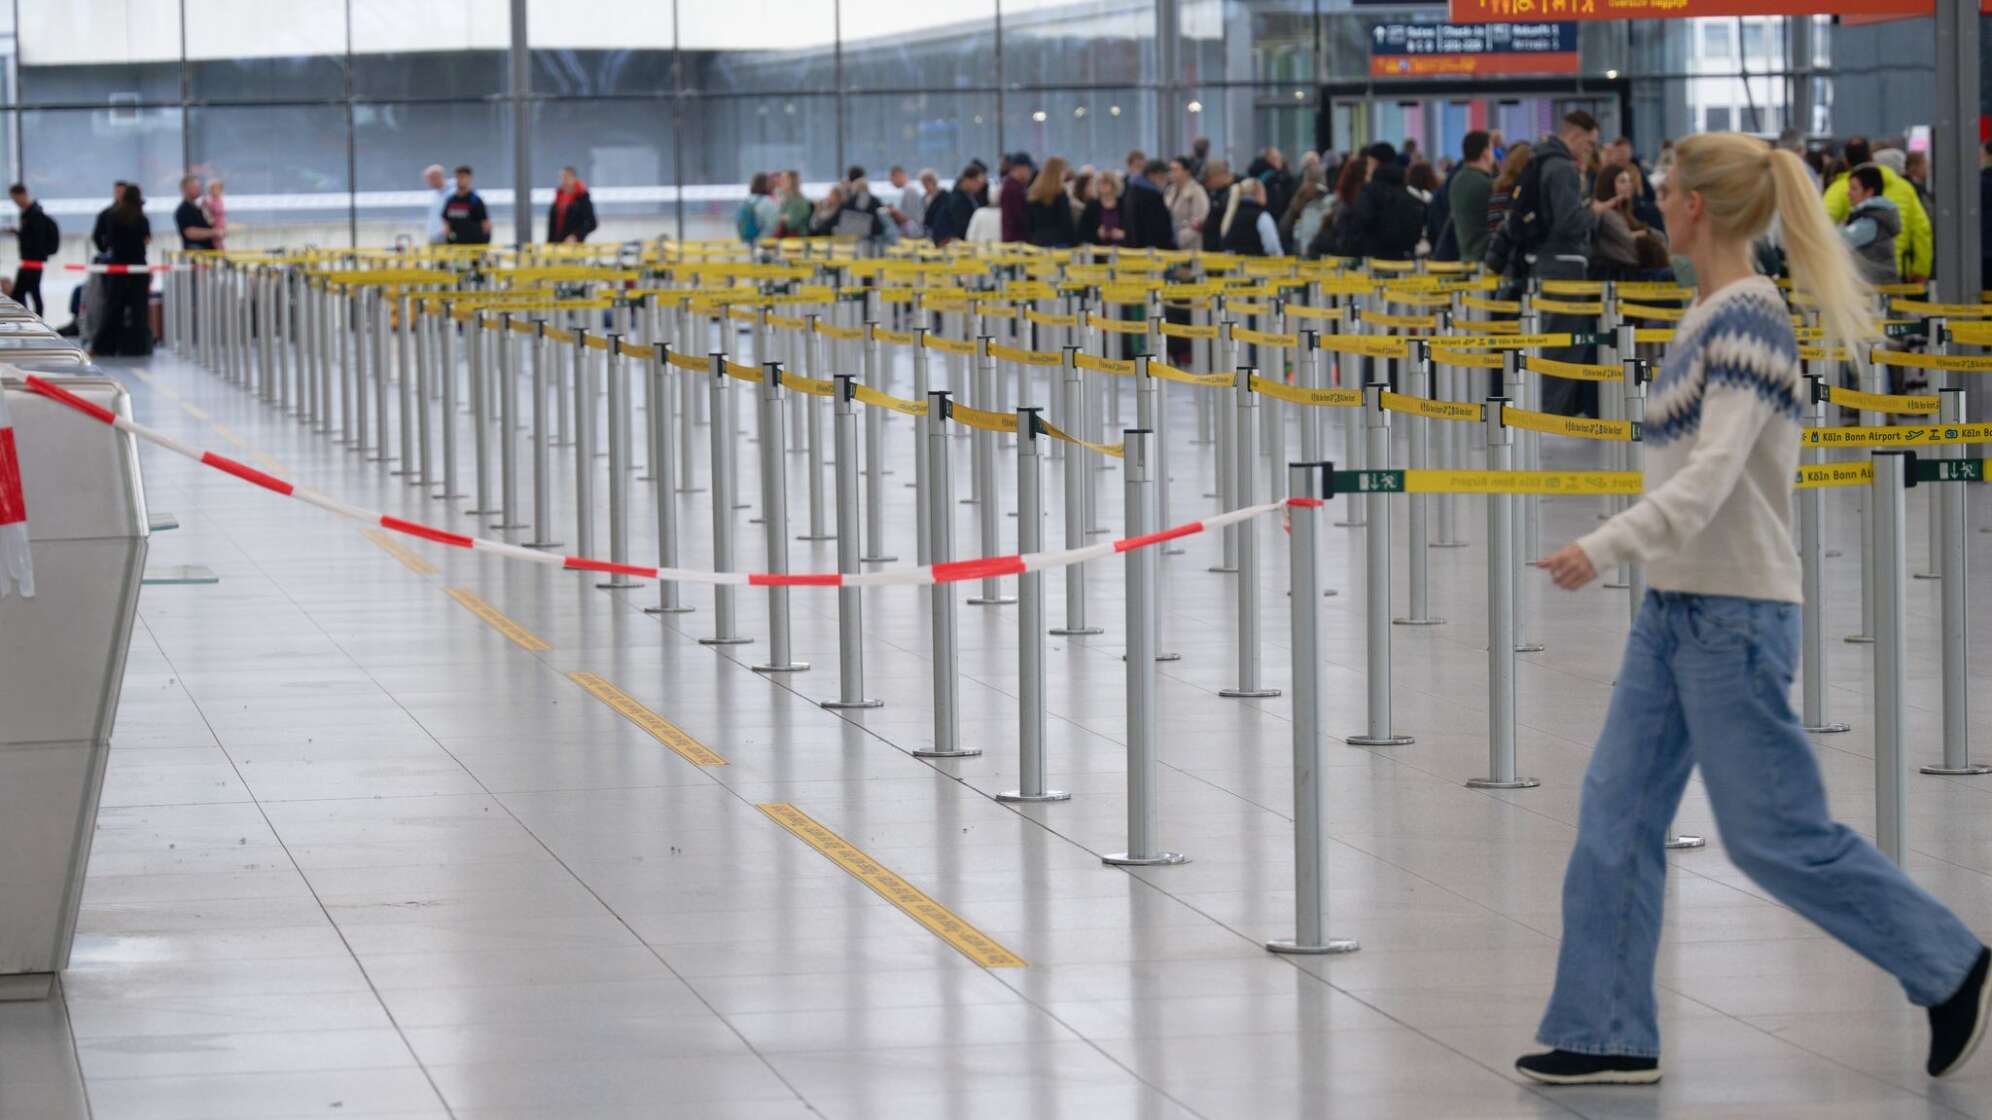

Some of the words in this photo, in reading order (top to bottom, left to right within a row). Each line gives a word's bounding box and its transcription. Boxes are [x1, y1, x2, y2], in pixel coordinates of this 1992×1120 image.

[1823, 432, 1842, 441] Köln
[1845, 431, 1866, 441] Bonn
[1868, 431, 1901, 443] Airport
[1962, 429, 1982, 438] Köln
[1808, 471, 1830, 481] Köln
[1834, 470, 1857, 480] Bonn
